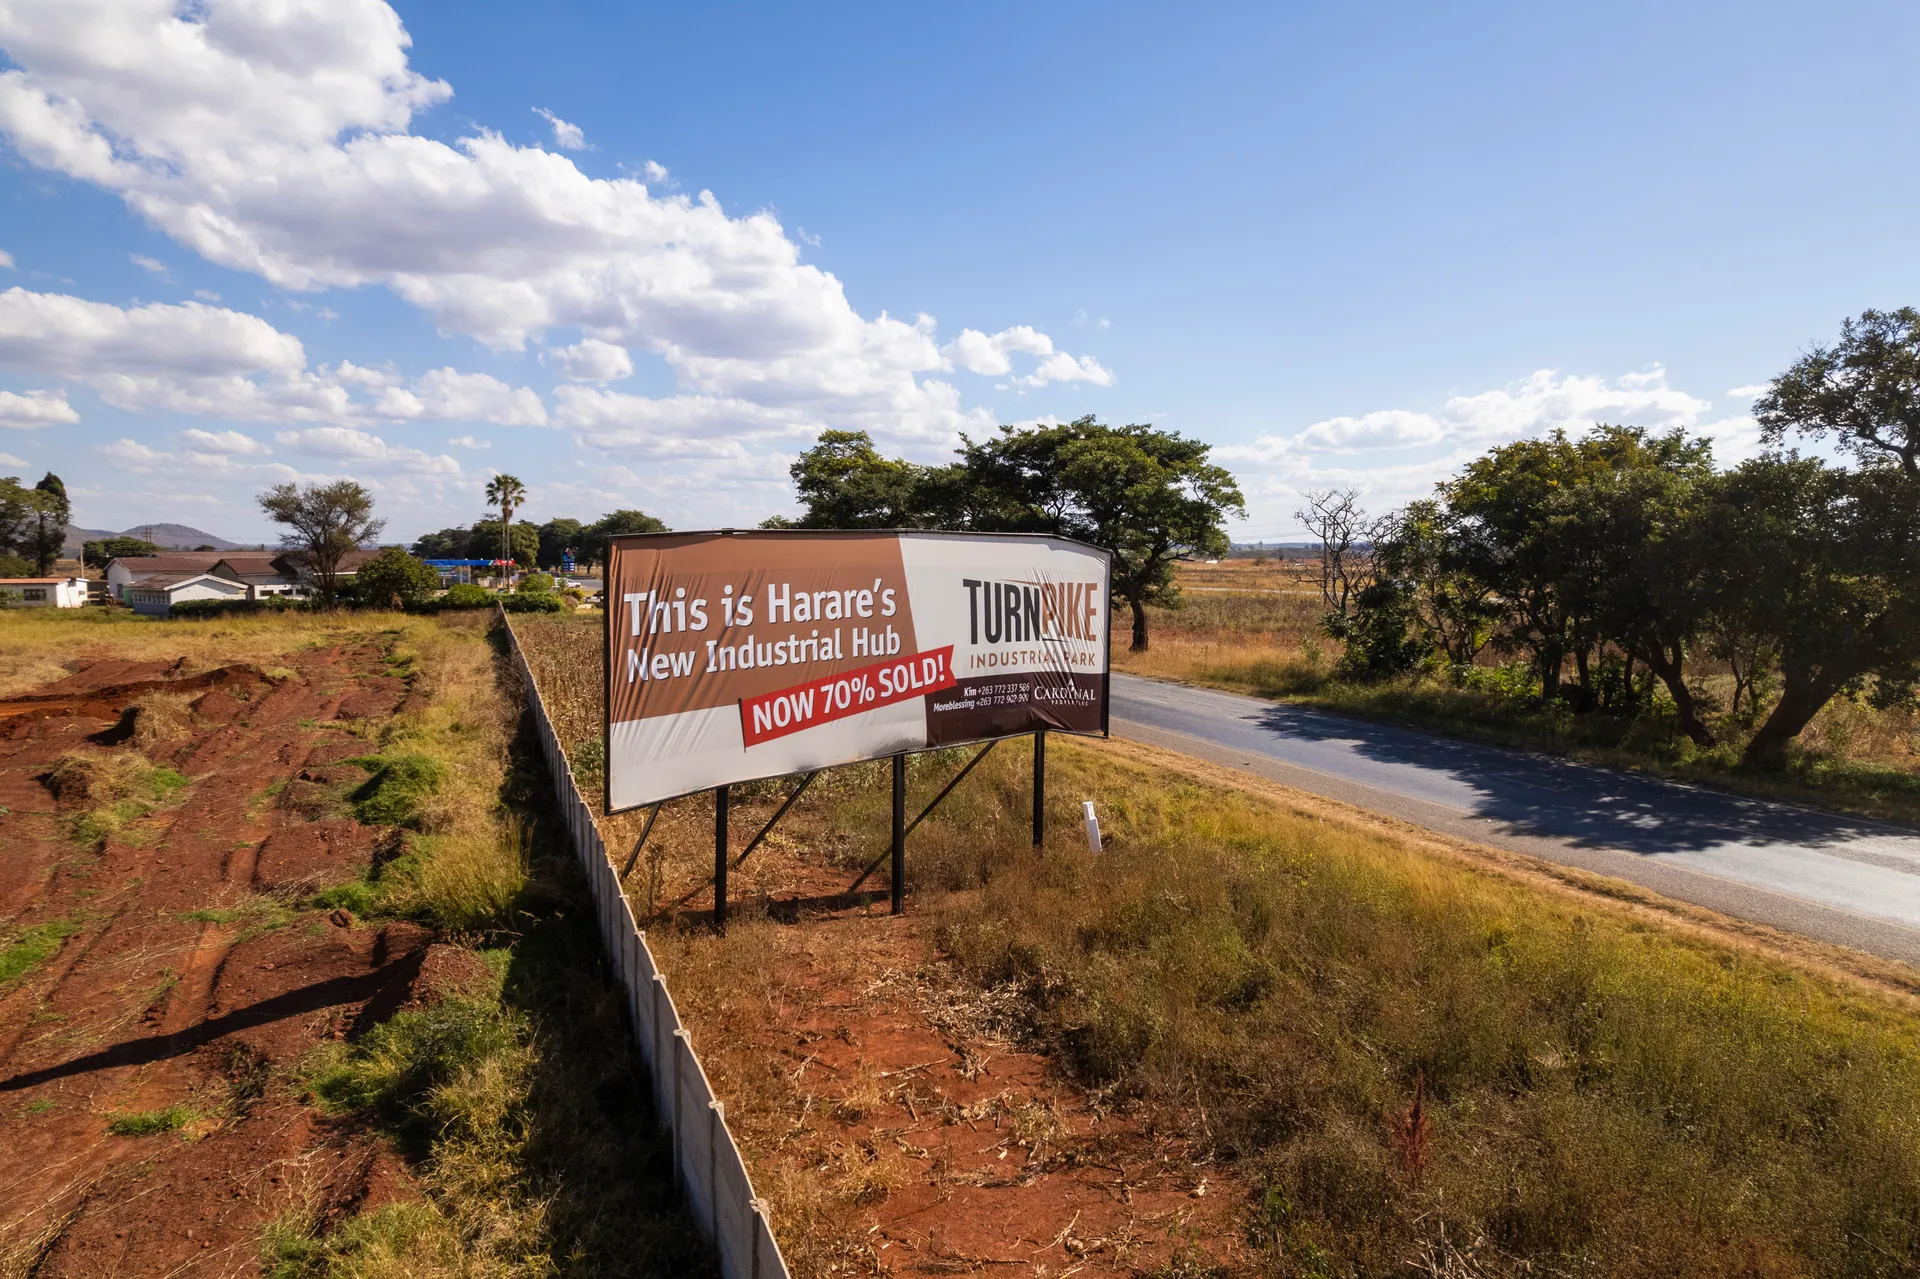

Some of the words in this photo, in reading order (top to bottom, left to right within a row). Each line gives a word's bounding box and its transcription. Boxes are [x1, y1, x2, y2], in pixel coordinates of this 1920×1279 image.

[624, 587, 709, 637] This
[721, 585, 754, 628] is
[768, 578, 897, 624] Harare's
[962, 578, 1098, 645] TURNPIKE
[628, 647, 696, 683] New
[706, 628, 844, 673] Industrial
[852, 624, 901, 657] Hub
[970, 650, 1058, 669] INDUSTRIAL
[752, 688, 814, 735] NOW
[820, 674, 876, 715] 70%
[878, 654, 946, 699] SOLD!
[933, 698, 975, 712] Moreblessing
[976, 696, 992, 707] +263
[993, 695, 1005, 705] 772
[963, 687, 977, 697] Kim
[977, 685, 993, 696] +263
[994, 684, 1006, 694] 772
[1007, 683, 1018, 693] 337
[1034, 686, 1097, 701] CARDINAL
